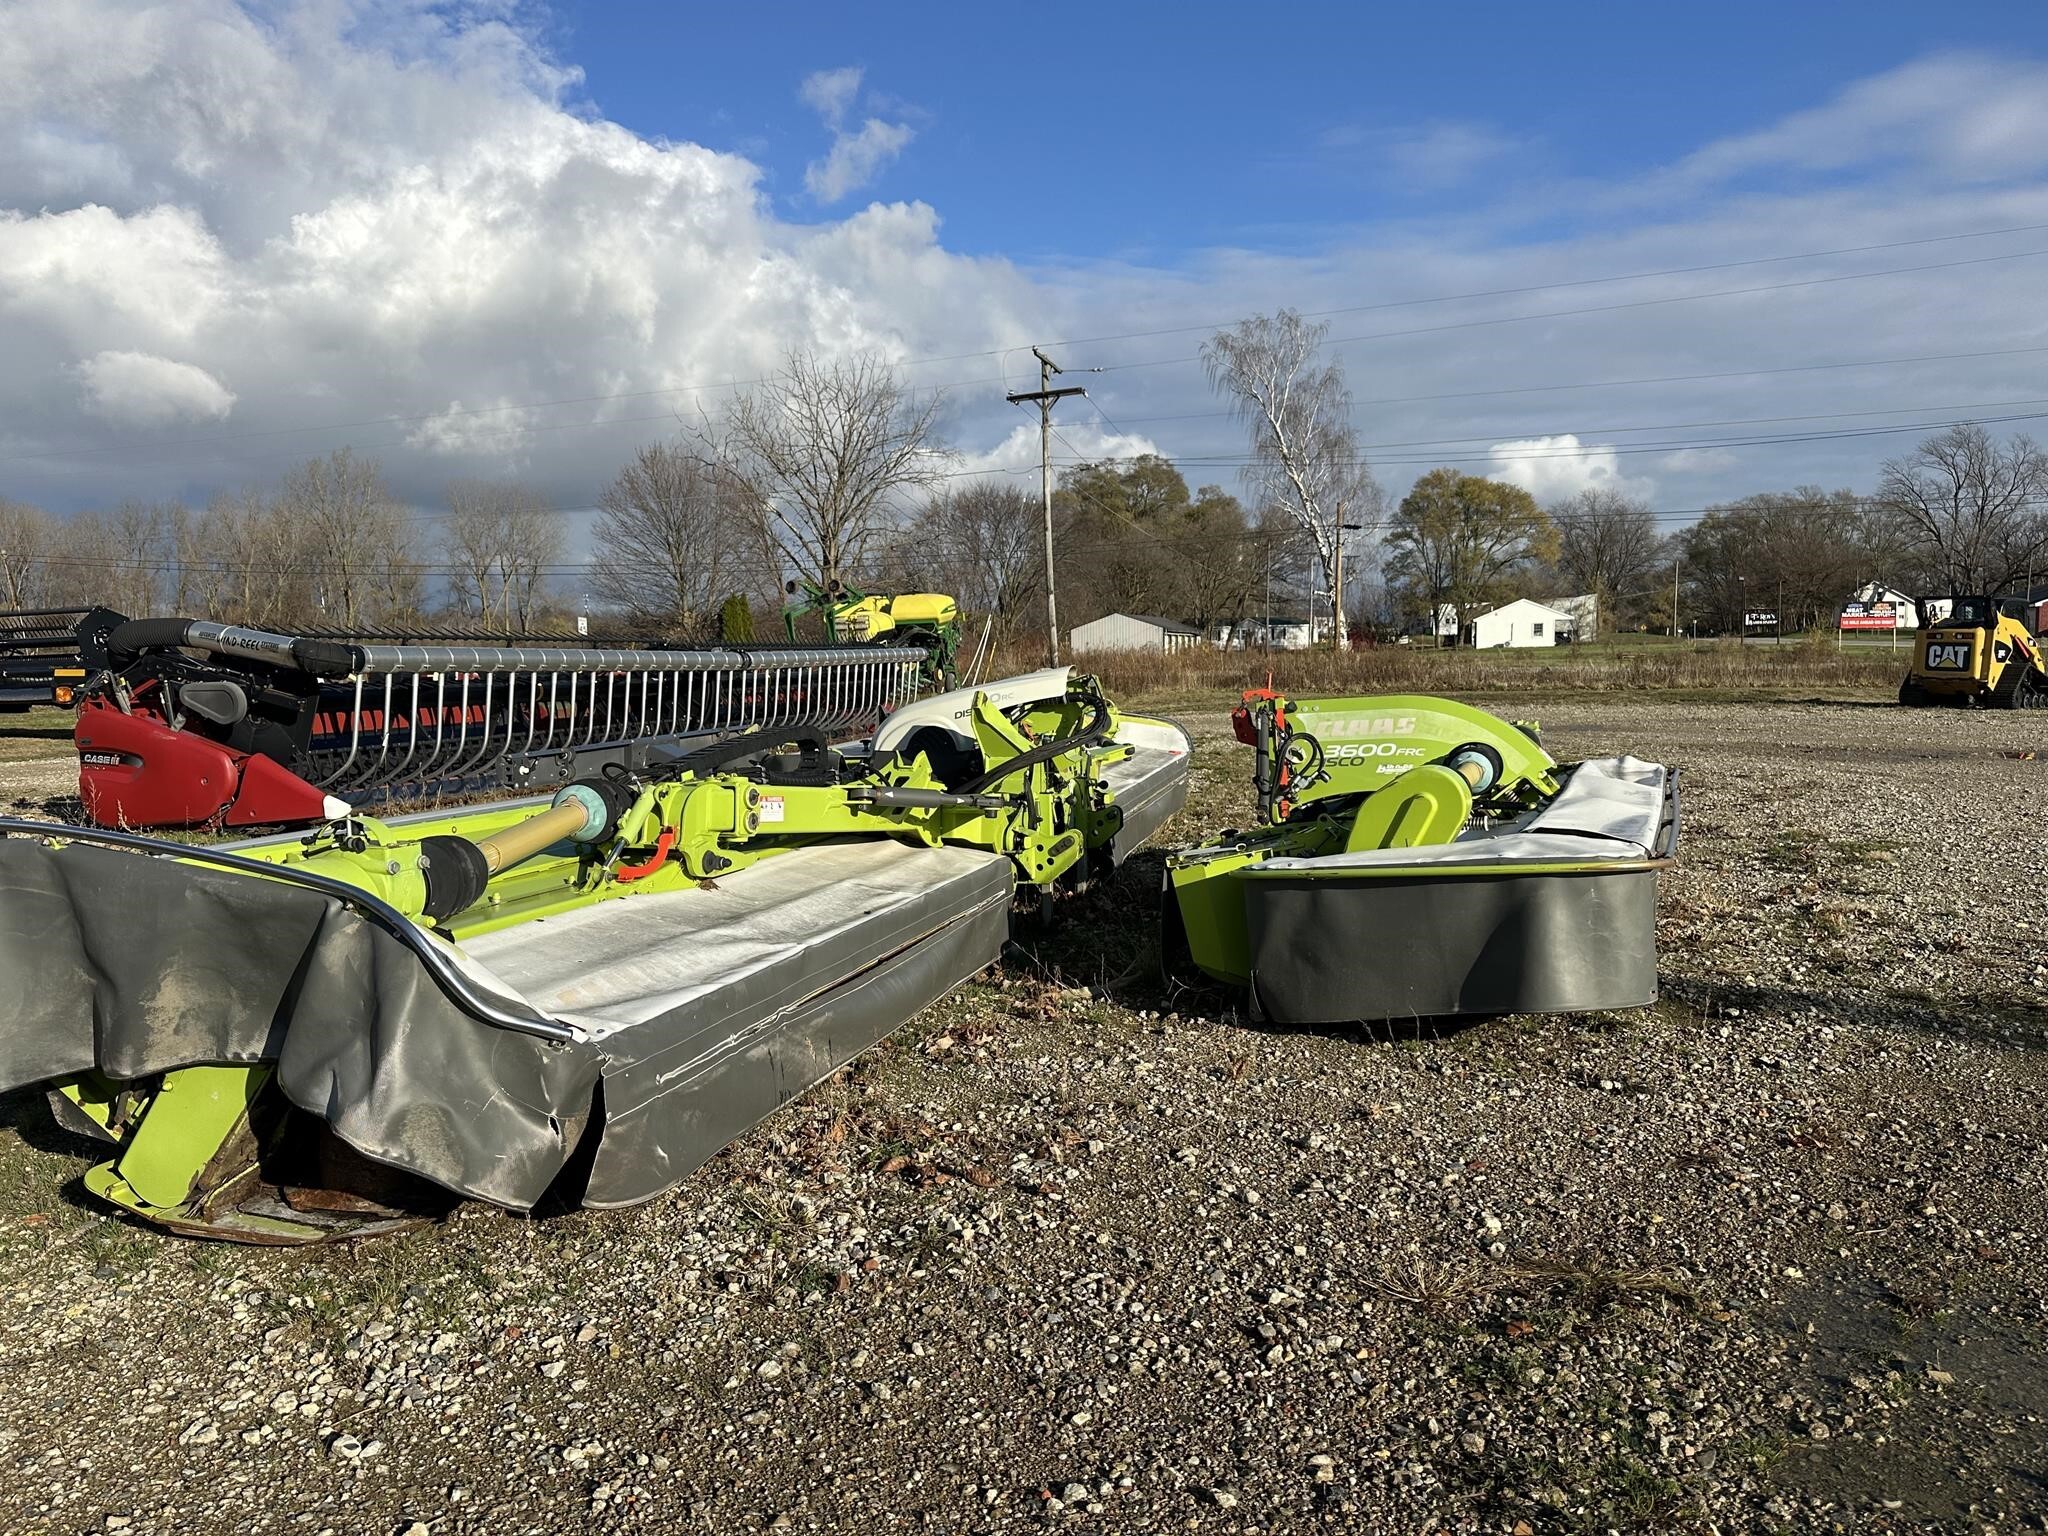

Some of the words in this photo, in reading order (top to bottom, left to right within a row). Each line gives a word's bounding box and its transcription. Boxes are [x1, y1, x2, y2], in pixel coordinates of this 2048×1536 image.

[1929, 645, 1968, 668] CAT
[1316, 718, 1416, 736] CLAAS
[1324, 743, 1397, 758] 3600
[1396, 748, 1426, 756] FRC
[84, 754, 110, 764] CASE
